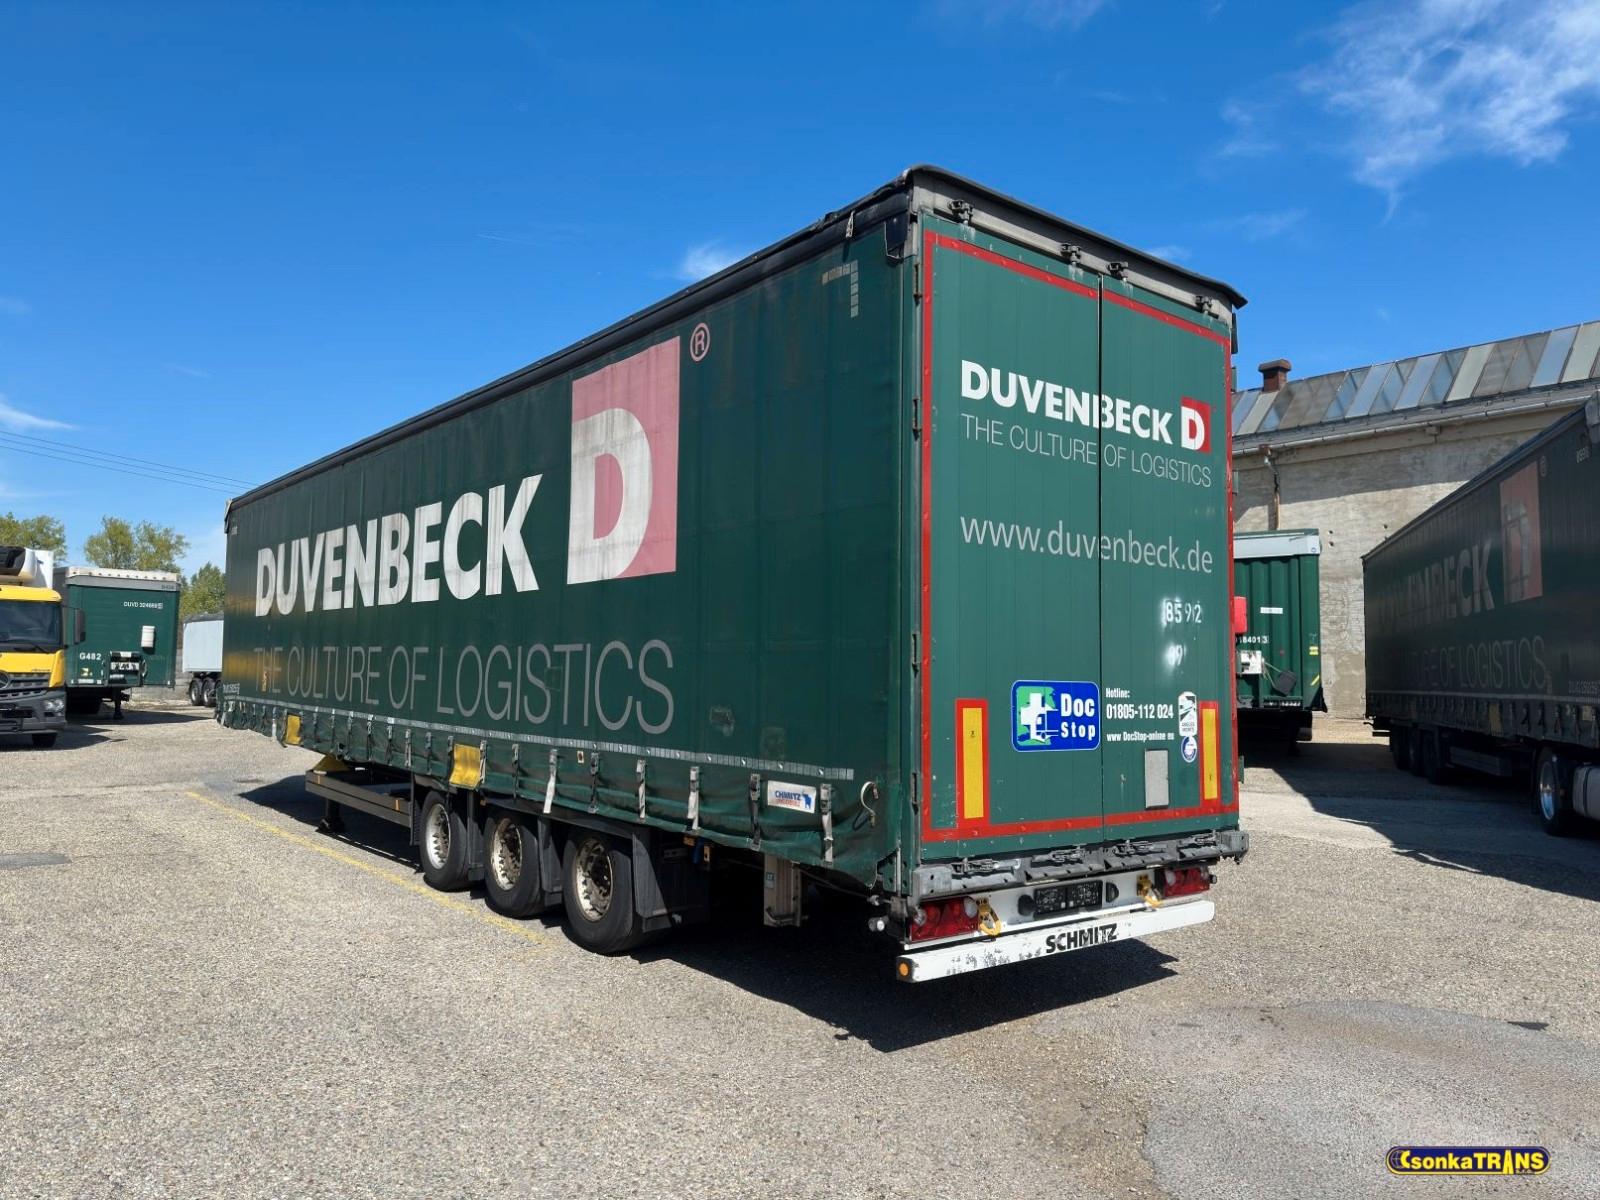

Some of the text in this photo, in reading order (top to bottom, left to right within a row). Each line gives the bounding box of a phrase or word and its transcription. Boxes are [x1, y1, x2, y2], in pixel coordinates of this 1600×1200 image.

[961, 359, 1205, 451] DUVENBECK D
[961, 413, 1212, 488] THE CULTURE OF LOGISTICS
[255, 407, 652, 617] DUVENBECK D
[960, 515, 1213, 574] www.duvenbeck.de
[1378, 538, 1496, 632] ENBECK
[254, 639, 674, 734] THE CULTURE OF LOGISTICS
[1459, 635, 1547, 690] LOGISTICS
[1060, 693, 1095, 717] Doc
[1105, 688, 1131, 698] Hotline:
[1106, 703, 1174, 719] 01805-112 024
[1061, 721, 1096, 741] Stop
[1106, 731, 1175, 743] wwwDocStop-onlineeu
[1045, 923, 1118, 954] SCHMITZ
